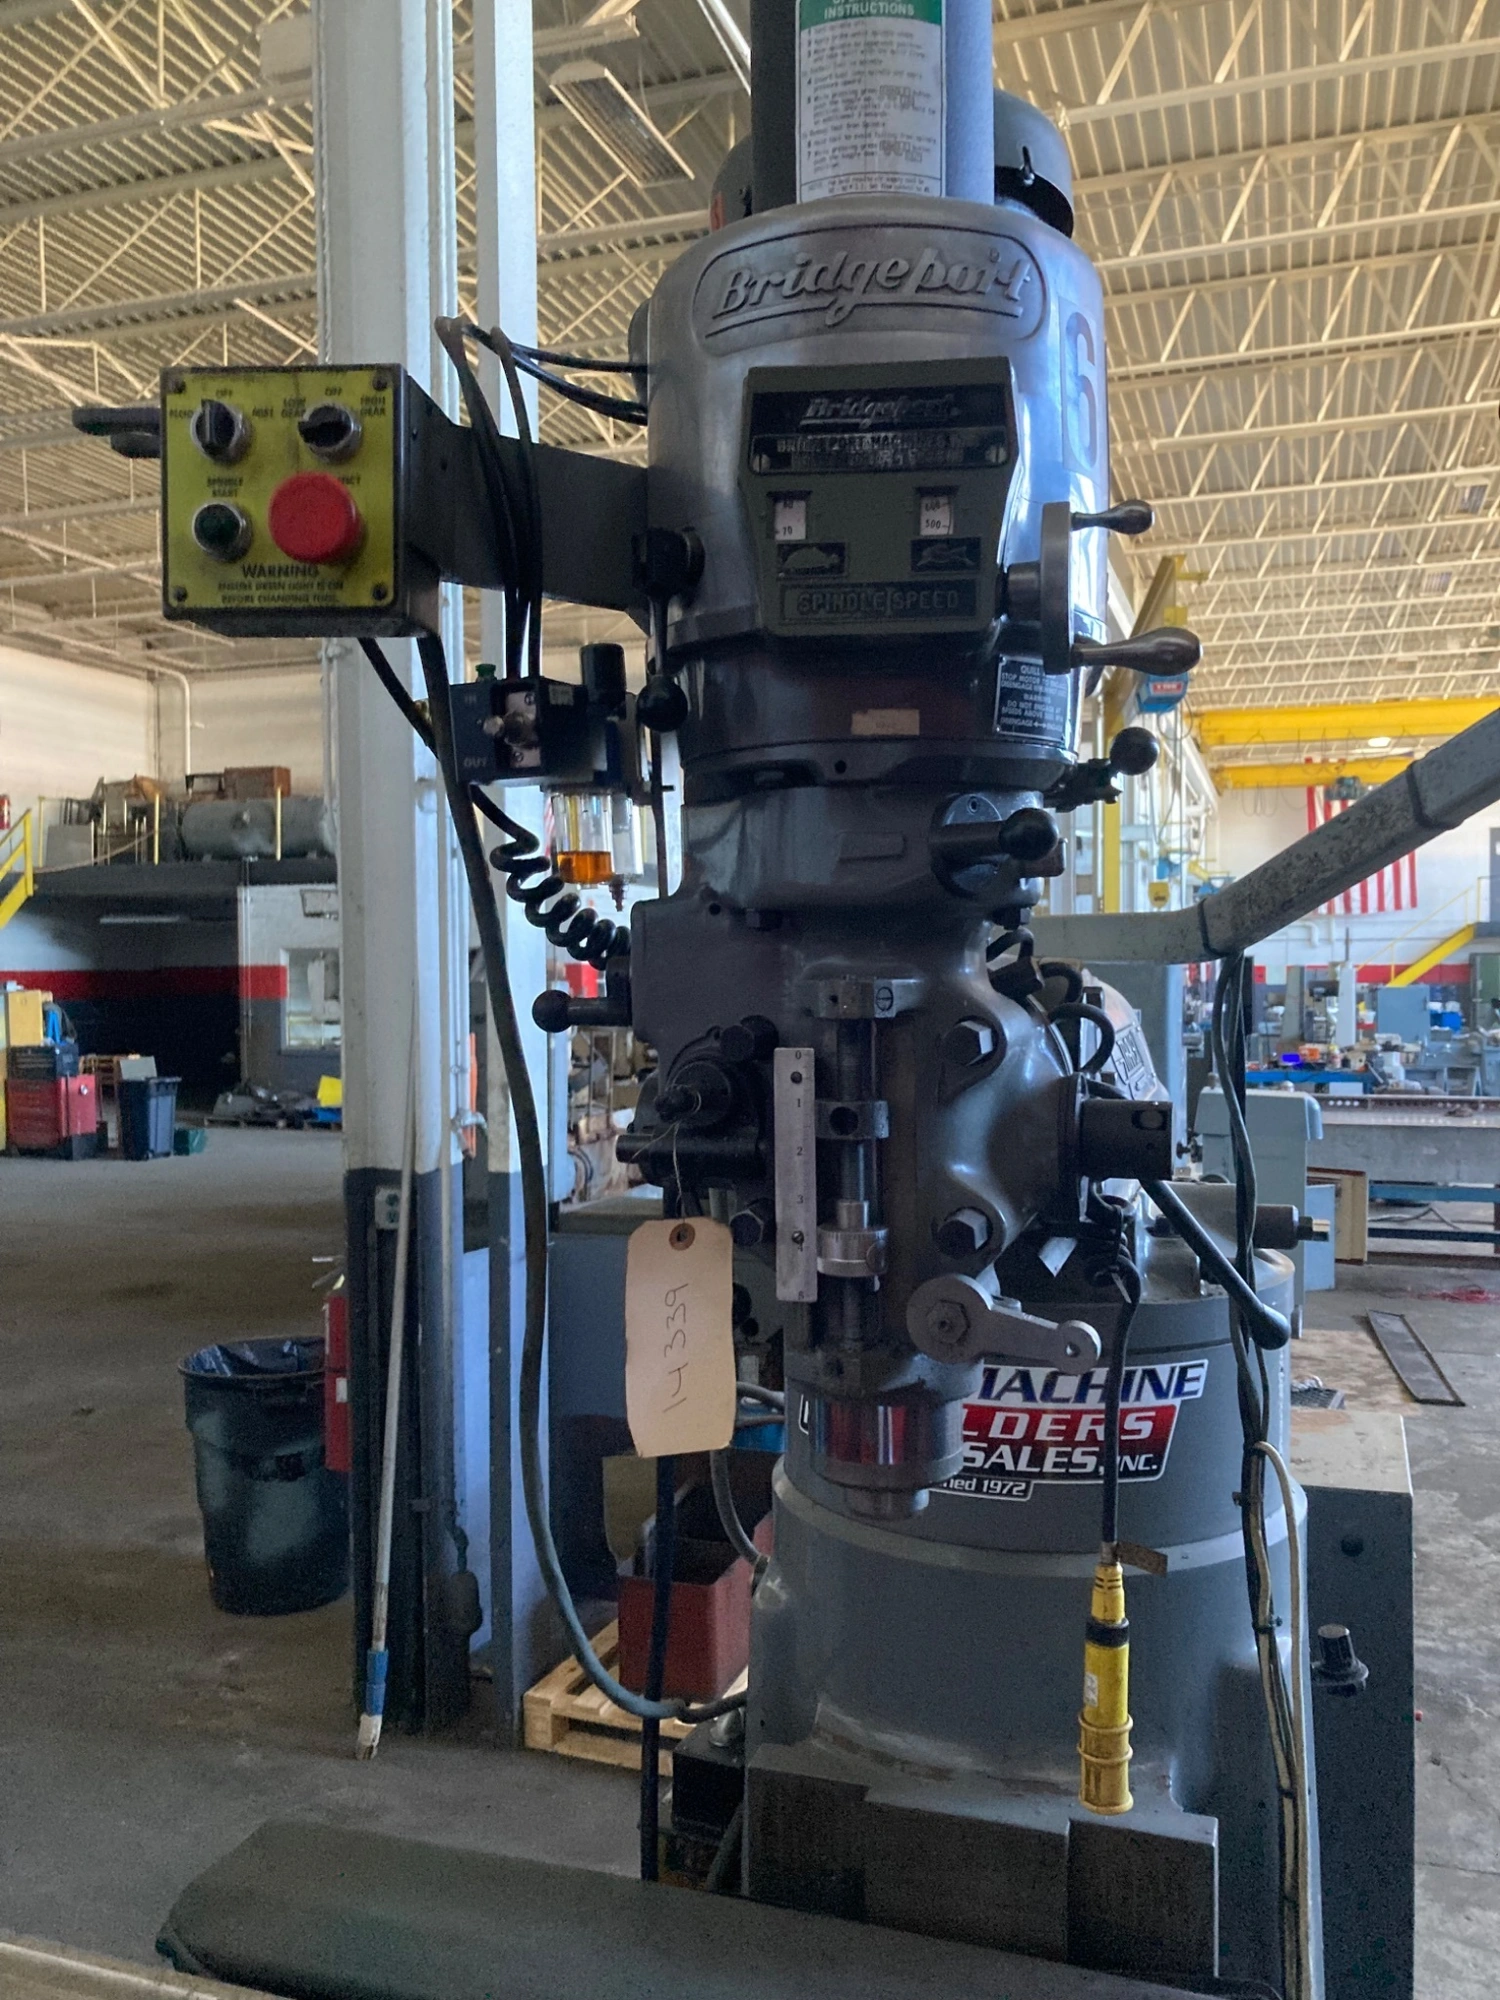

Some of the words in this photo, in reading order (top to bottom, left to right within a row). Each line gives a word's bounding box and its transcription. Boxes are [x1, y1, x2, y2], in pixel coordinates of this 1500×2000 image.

[824, 3, 915, 19] INSTRUCTIONS
[705, 246, 1032, 328] Bridgeport
[242, 563, 320, 579] WARNING
[798, 591, 886, 615] SPINDLE
[892, 589, 959, 611] SPEED
[464, 757, 487, 768] OUT
[796, 1146, 803, 1156] 2
[662, 1282, 689, 1413] 14339
[963, 1409, 1157, 1443] LDERS
[982, 1479, 1027, 1496] 1972
